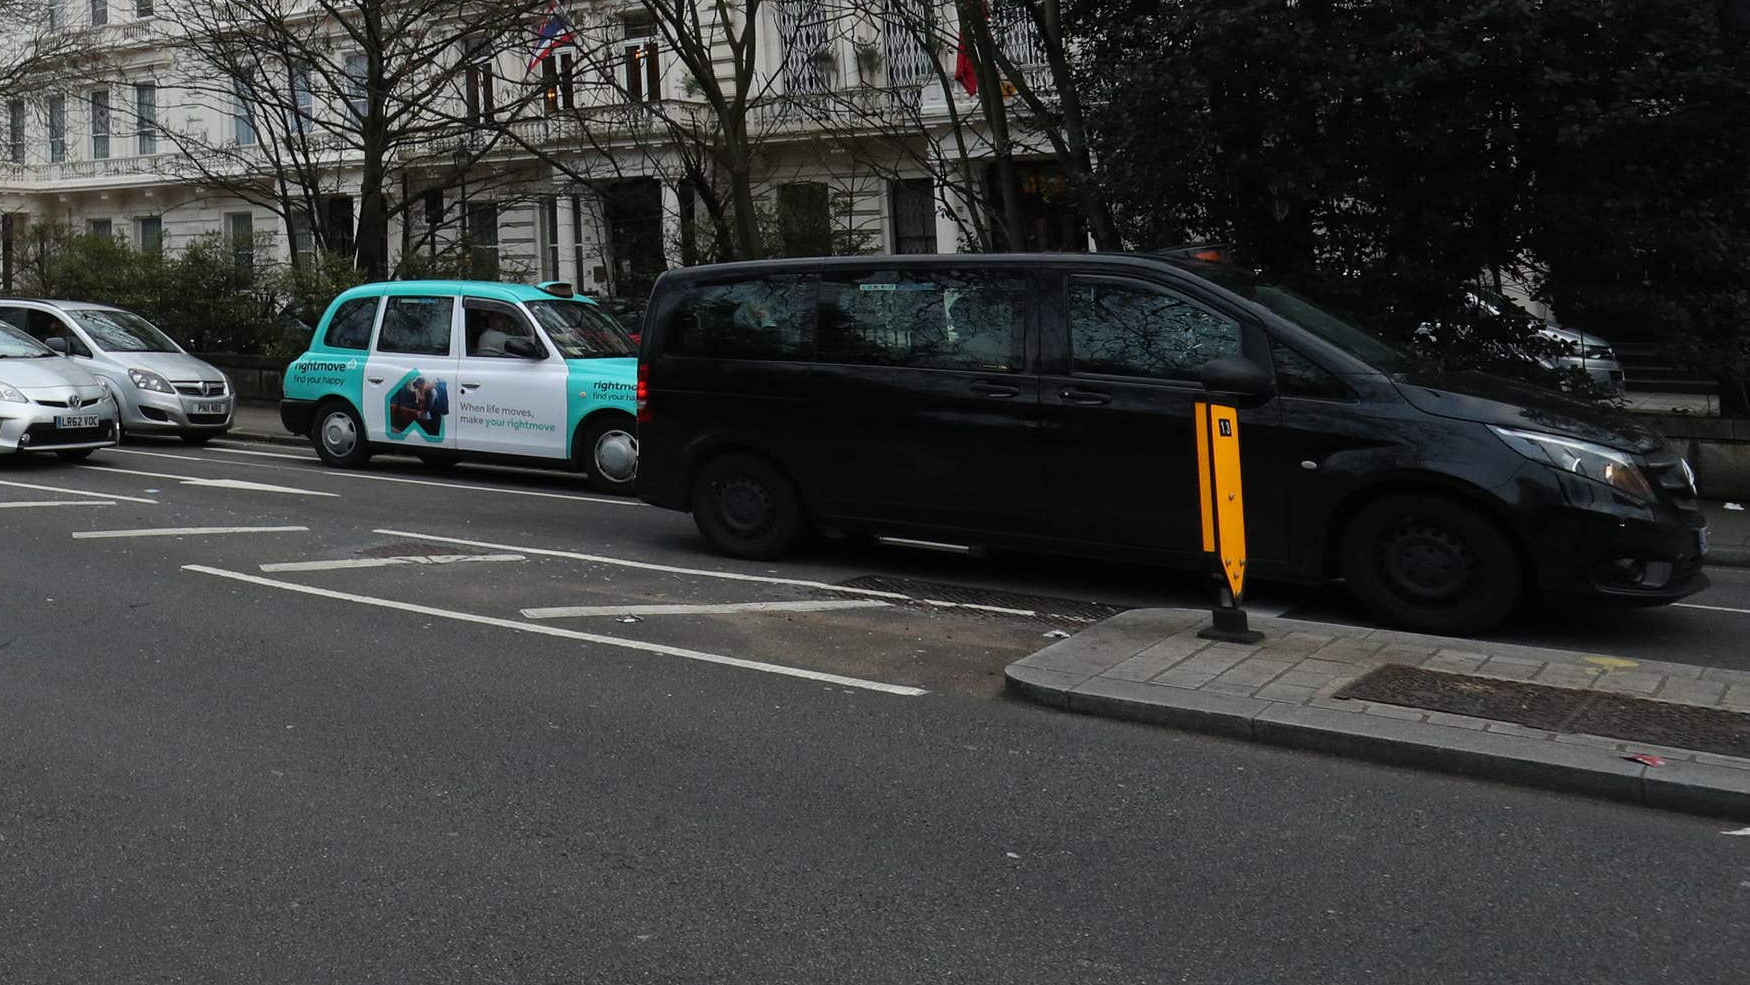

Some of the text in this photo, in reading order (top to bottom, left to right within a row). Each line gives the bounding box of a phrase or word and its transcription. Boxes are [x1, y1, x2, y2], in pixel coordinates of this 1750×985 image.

[295, 361, 346, 373] rightmove
[293, 375, 345, 387] find your happy
[593, 381, 637, 391] rightmo
[459, 402, 534, 418] When life moves,
[62, 416, 83, 427] LR62
[460, 415, 555, 432] make your rightmove
[1220, 420, 1230, 435] 13
